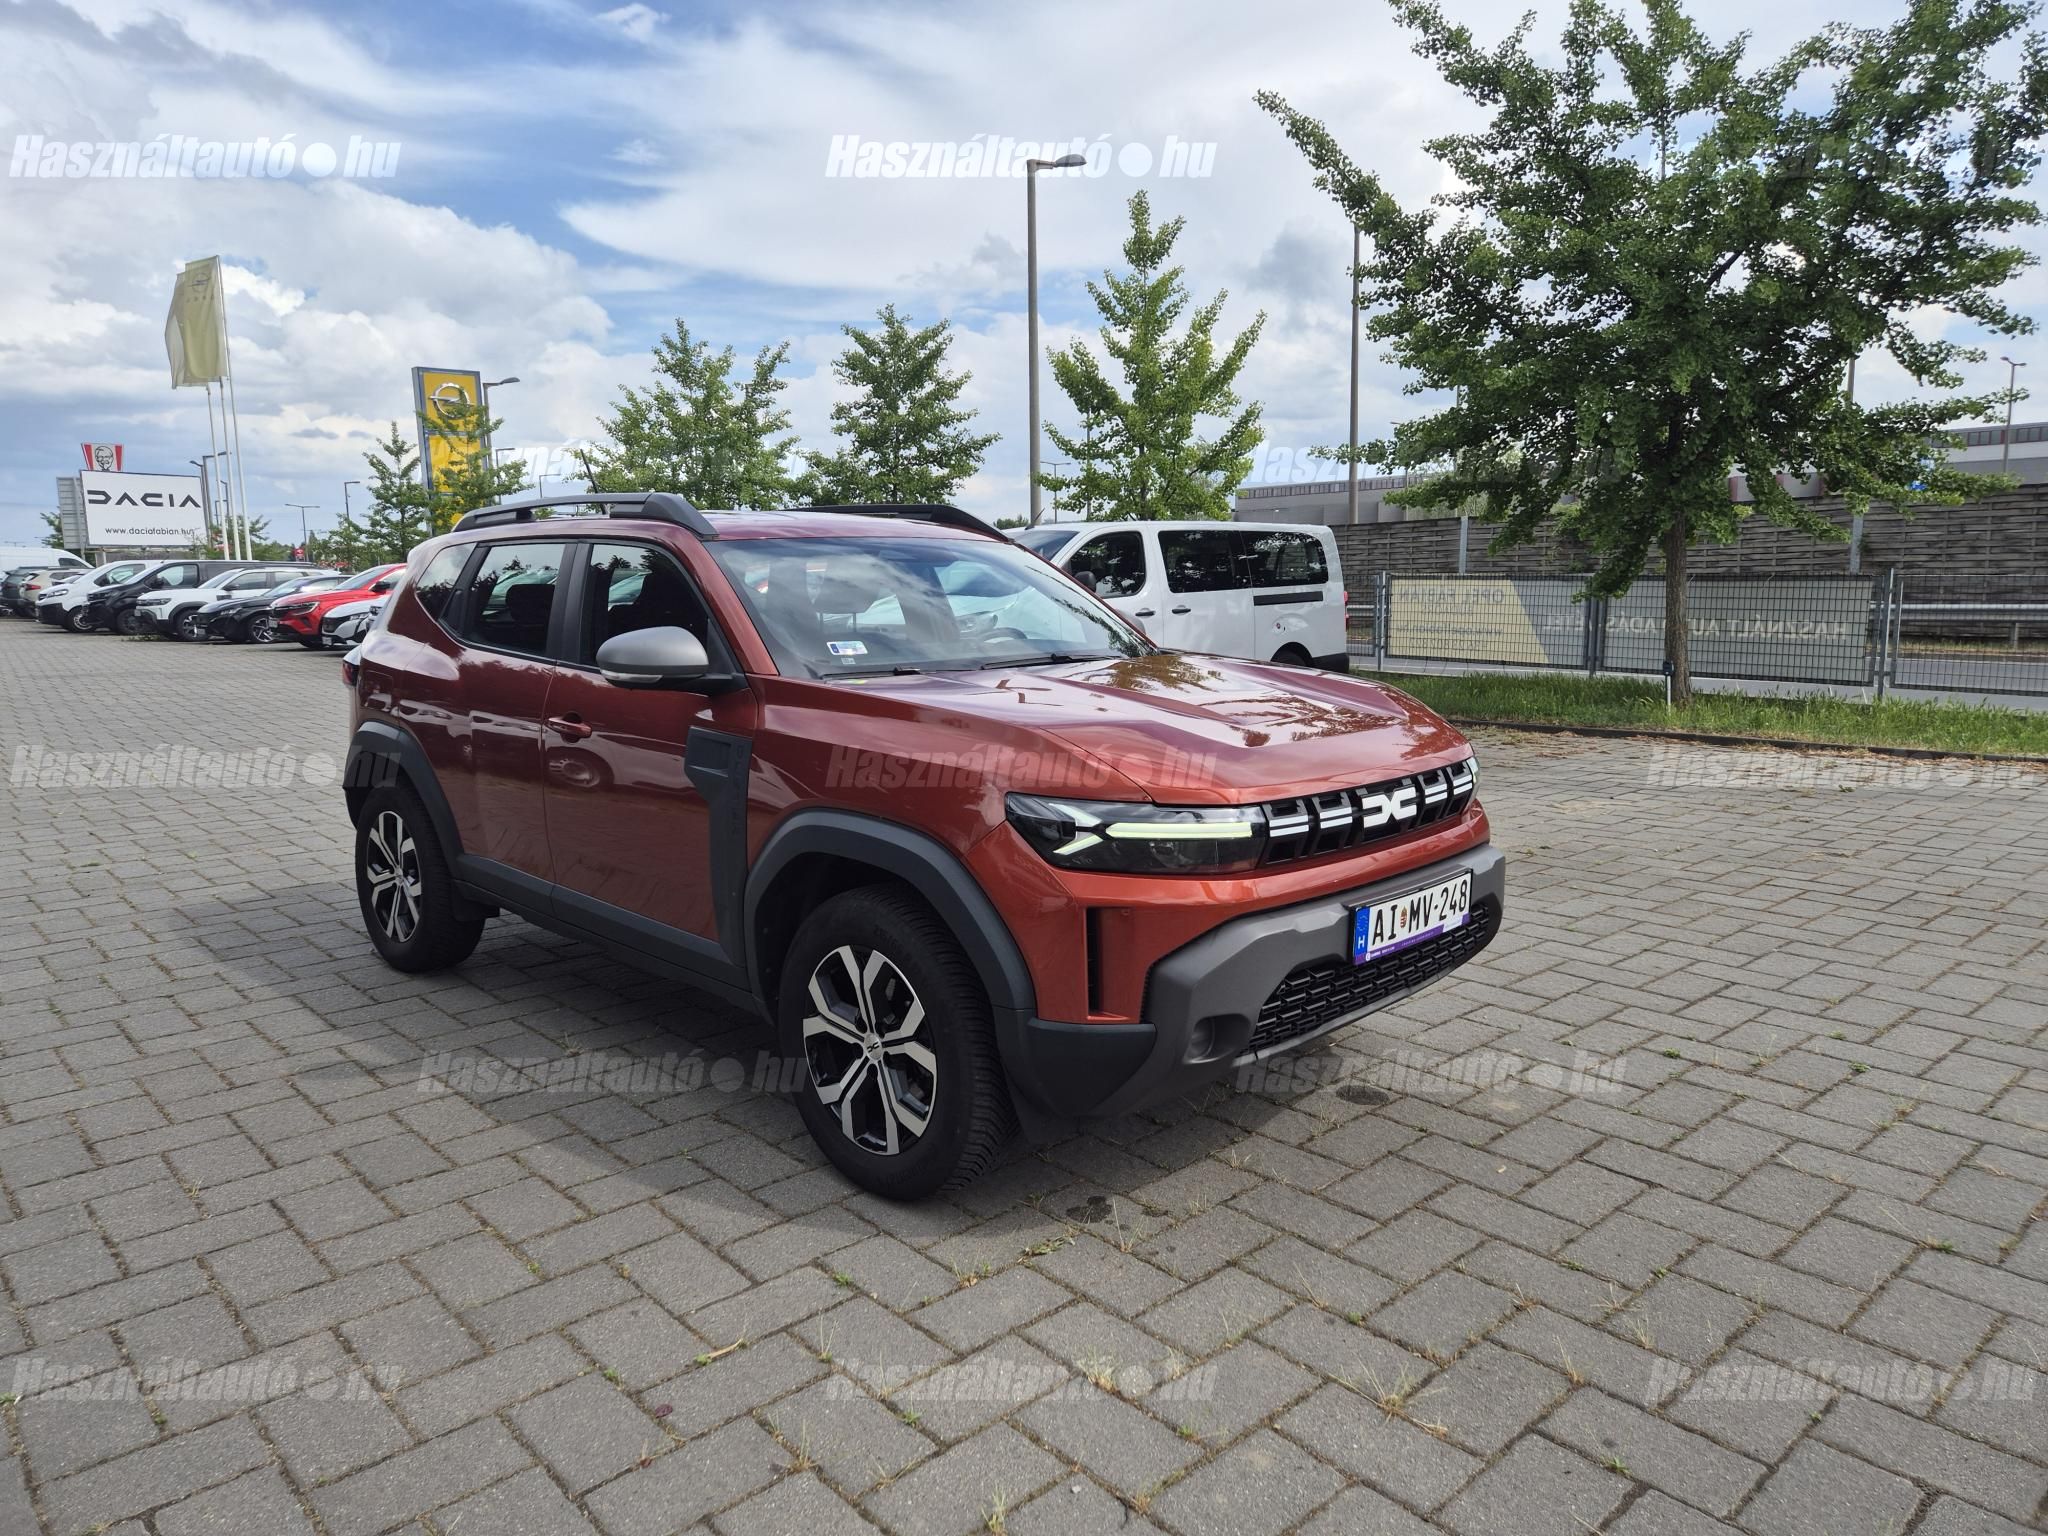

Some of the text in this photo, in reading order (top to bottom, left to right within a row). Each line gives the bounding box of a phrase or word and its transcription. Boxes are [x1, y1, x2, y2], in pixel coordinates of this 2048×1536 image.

[87, 489, 201, 508] DACIA
[105, 527, 192, 536] www.daciafabian.hu
[1372, 904, 1398, 946] AI
[1357, 934, 1366, 949] H
